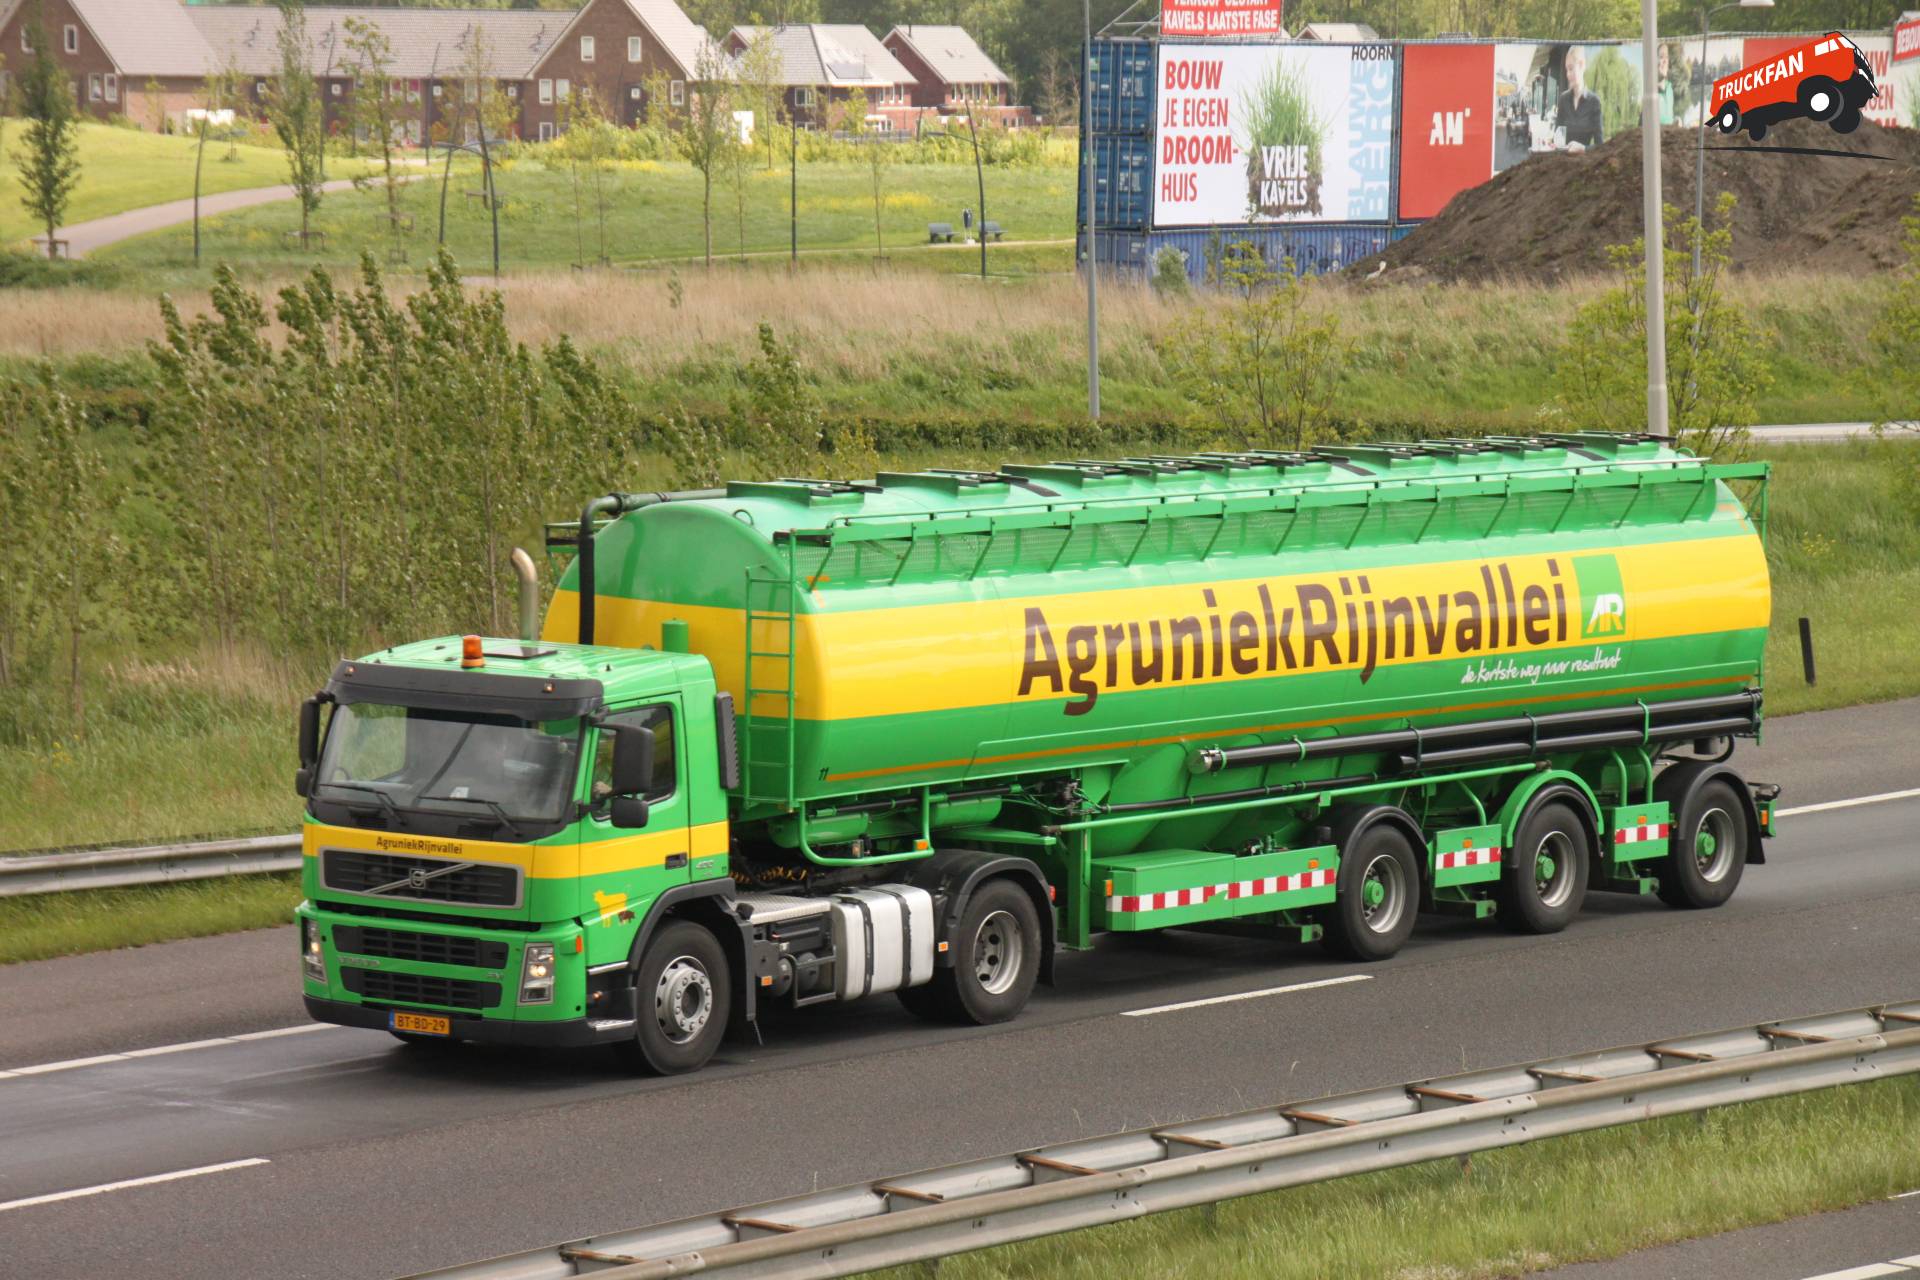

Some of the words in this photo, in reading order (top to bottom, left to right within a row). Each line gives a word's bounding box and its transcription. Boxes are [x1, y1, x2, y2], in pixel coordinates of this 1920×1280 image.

[1164, 10, 1204, 30] KAVELS
[1207, 10, 1251, 30] LAATSTE
[1253, 9, 1279, 29] FASE
[1351, 45, 1394, 61] HOORN
[1165, 60, 1223, 90] BOUW
[1163, 98, 1177, 127] JE
[1183, 98, 1228, 127] EIGEN
[1163, 135, 1239, 165] DROOM-
[1261, 145, 1308, 179] VRIJE
[1161, 173, 1198, 202] HUIS
[1260, 180, 1307, 206] KAVELS
[1018, 558, 1568, 717] AgruniekRijnvallei
[1461, 665, 1478, 684] de
[1519, 664, 1541, 685] weg
[1542, 661, 1570, 675] naar
[376, 836, 463, 855] AgruniekRijnvallei
[397, 1015, 446, 1032] BT-BD-29
